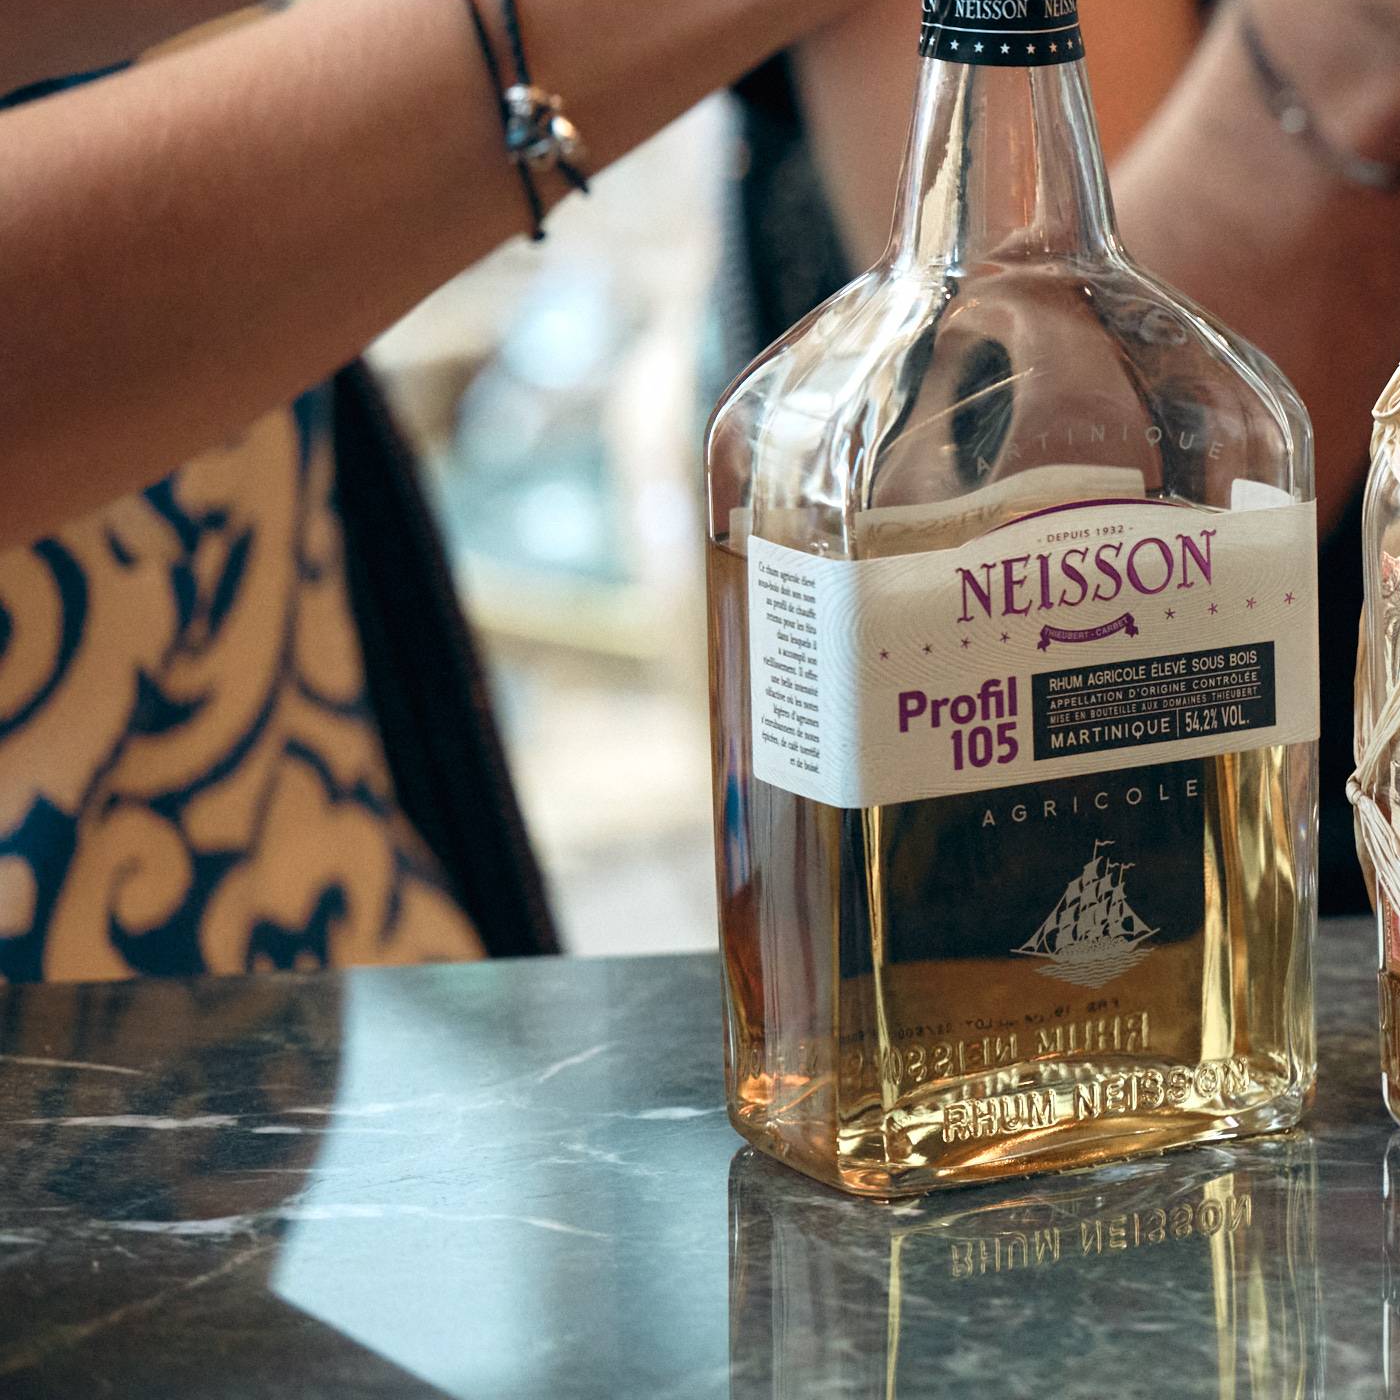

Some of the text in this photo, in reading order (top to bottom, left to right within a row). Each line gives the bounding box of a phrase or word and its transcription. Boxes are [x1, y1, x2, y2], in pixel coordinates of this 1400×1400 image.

[955, 0, 1028, 20] NEISSON
[975, 425, 1224, 471] ARTINIQUE
[1047, 525, 1124, 543] DEPUIS 1932
[955, 528, 1217, 623] NEISSON
[1049, 650, 1258, 691] RHUM AGRICOLE ÉLEVÉ SOUS BOIS
[1050, 671, 1258, 710] APPELLATION D'ORIGINE CONTRÔLÉE
[898, 676, 1018, 733] Profil
[1050, 687, 1258, 725] MISE EN BOUTEILLE AUX DOMAINES THIEUBERT
[1051, 717, 1171, 749] MARTINIQUE
[1221, 704, 1250, 727] VOL.
[951, 721, 1019, 771] 105
[981, 778, 1200, 827] AGRICOLE
[942, 1089, 1056, 1143] RHUM
[1074, 1057, 1251, 1121] NEISSON
